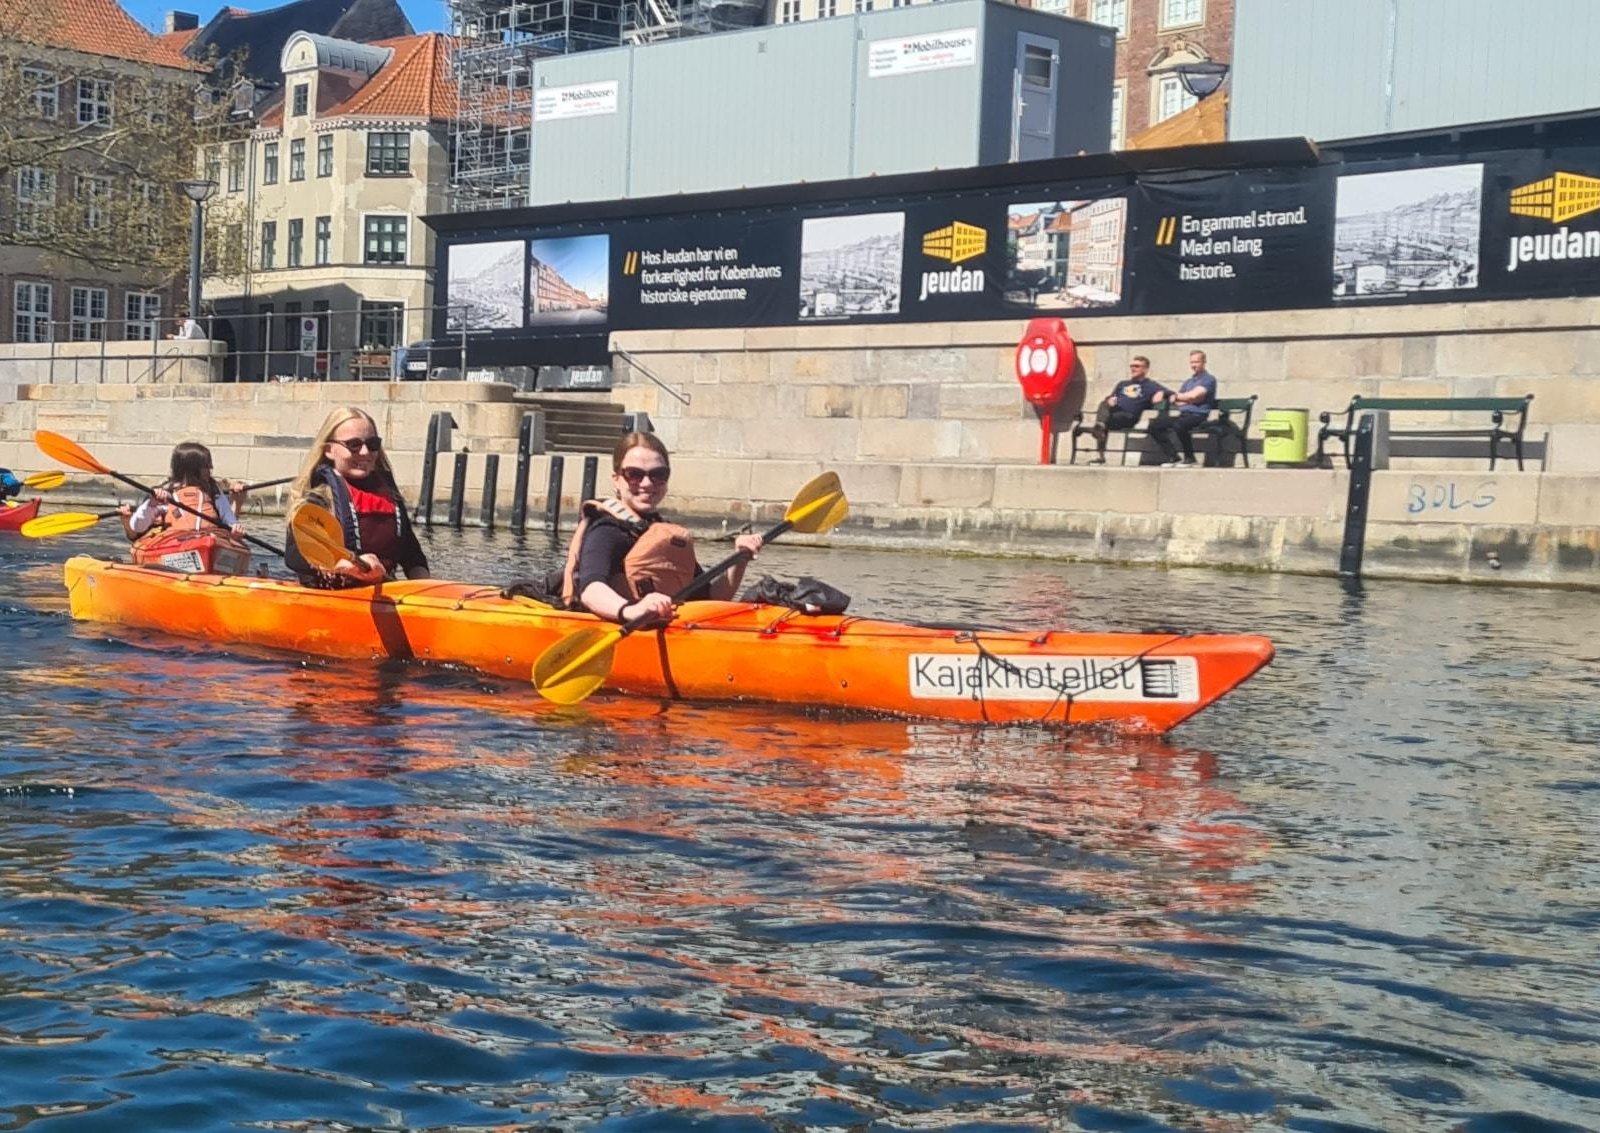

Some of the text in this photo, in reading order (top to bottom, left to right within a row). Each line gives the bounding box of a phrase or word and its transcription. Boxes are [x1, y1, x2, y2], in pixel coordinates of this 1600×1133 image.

[1181, 206, 1308, 237] En gammel strand.
[641, 246, 738, 265] Hos Jeudan har vi en
[1180, 235, 1263, 257] Med en lang
[1507, 226, 1600, 272] jeudan
[641, 263, 783, 287] forkærlighed for Københavns
[918, 265, 985, 302] jeudan
[1179, 262, 1237, 281] historie.
[640, 286, 748, 305] historiske ejendomme
[915, 656, 1135, 695] Kajakhotellet
